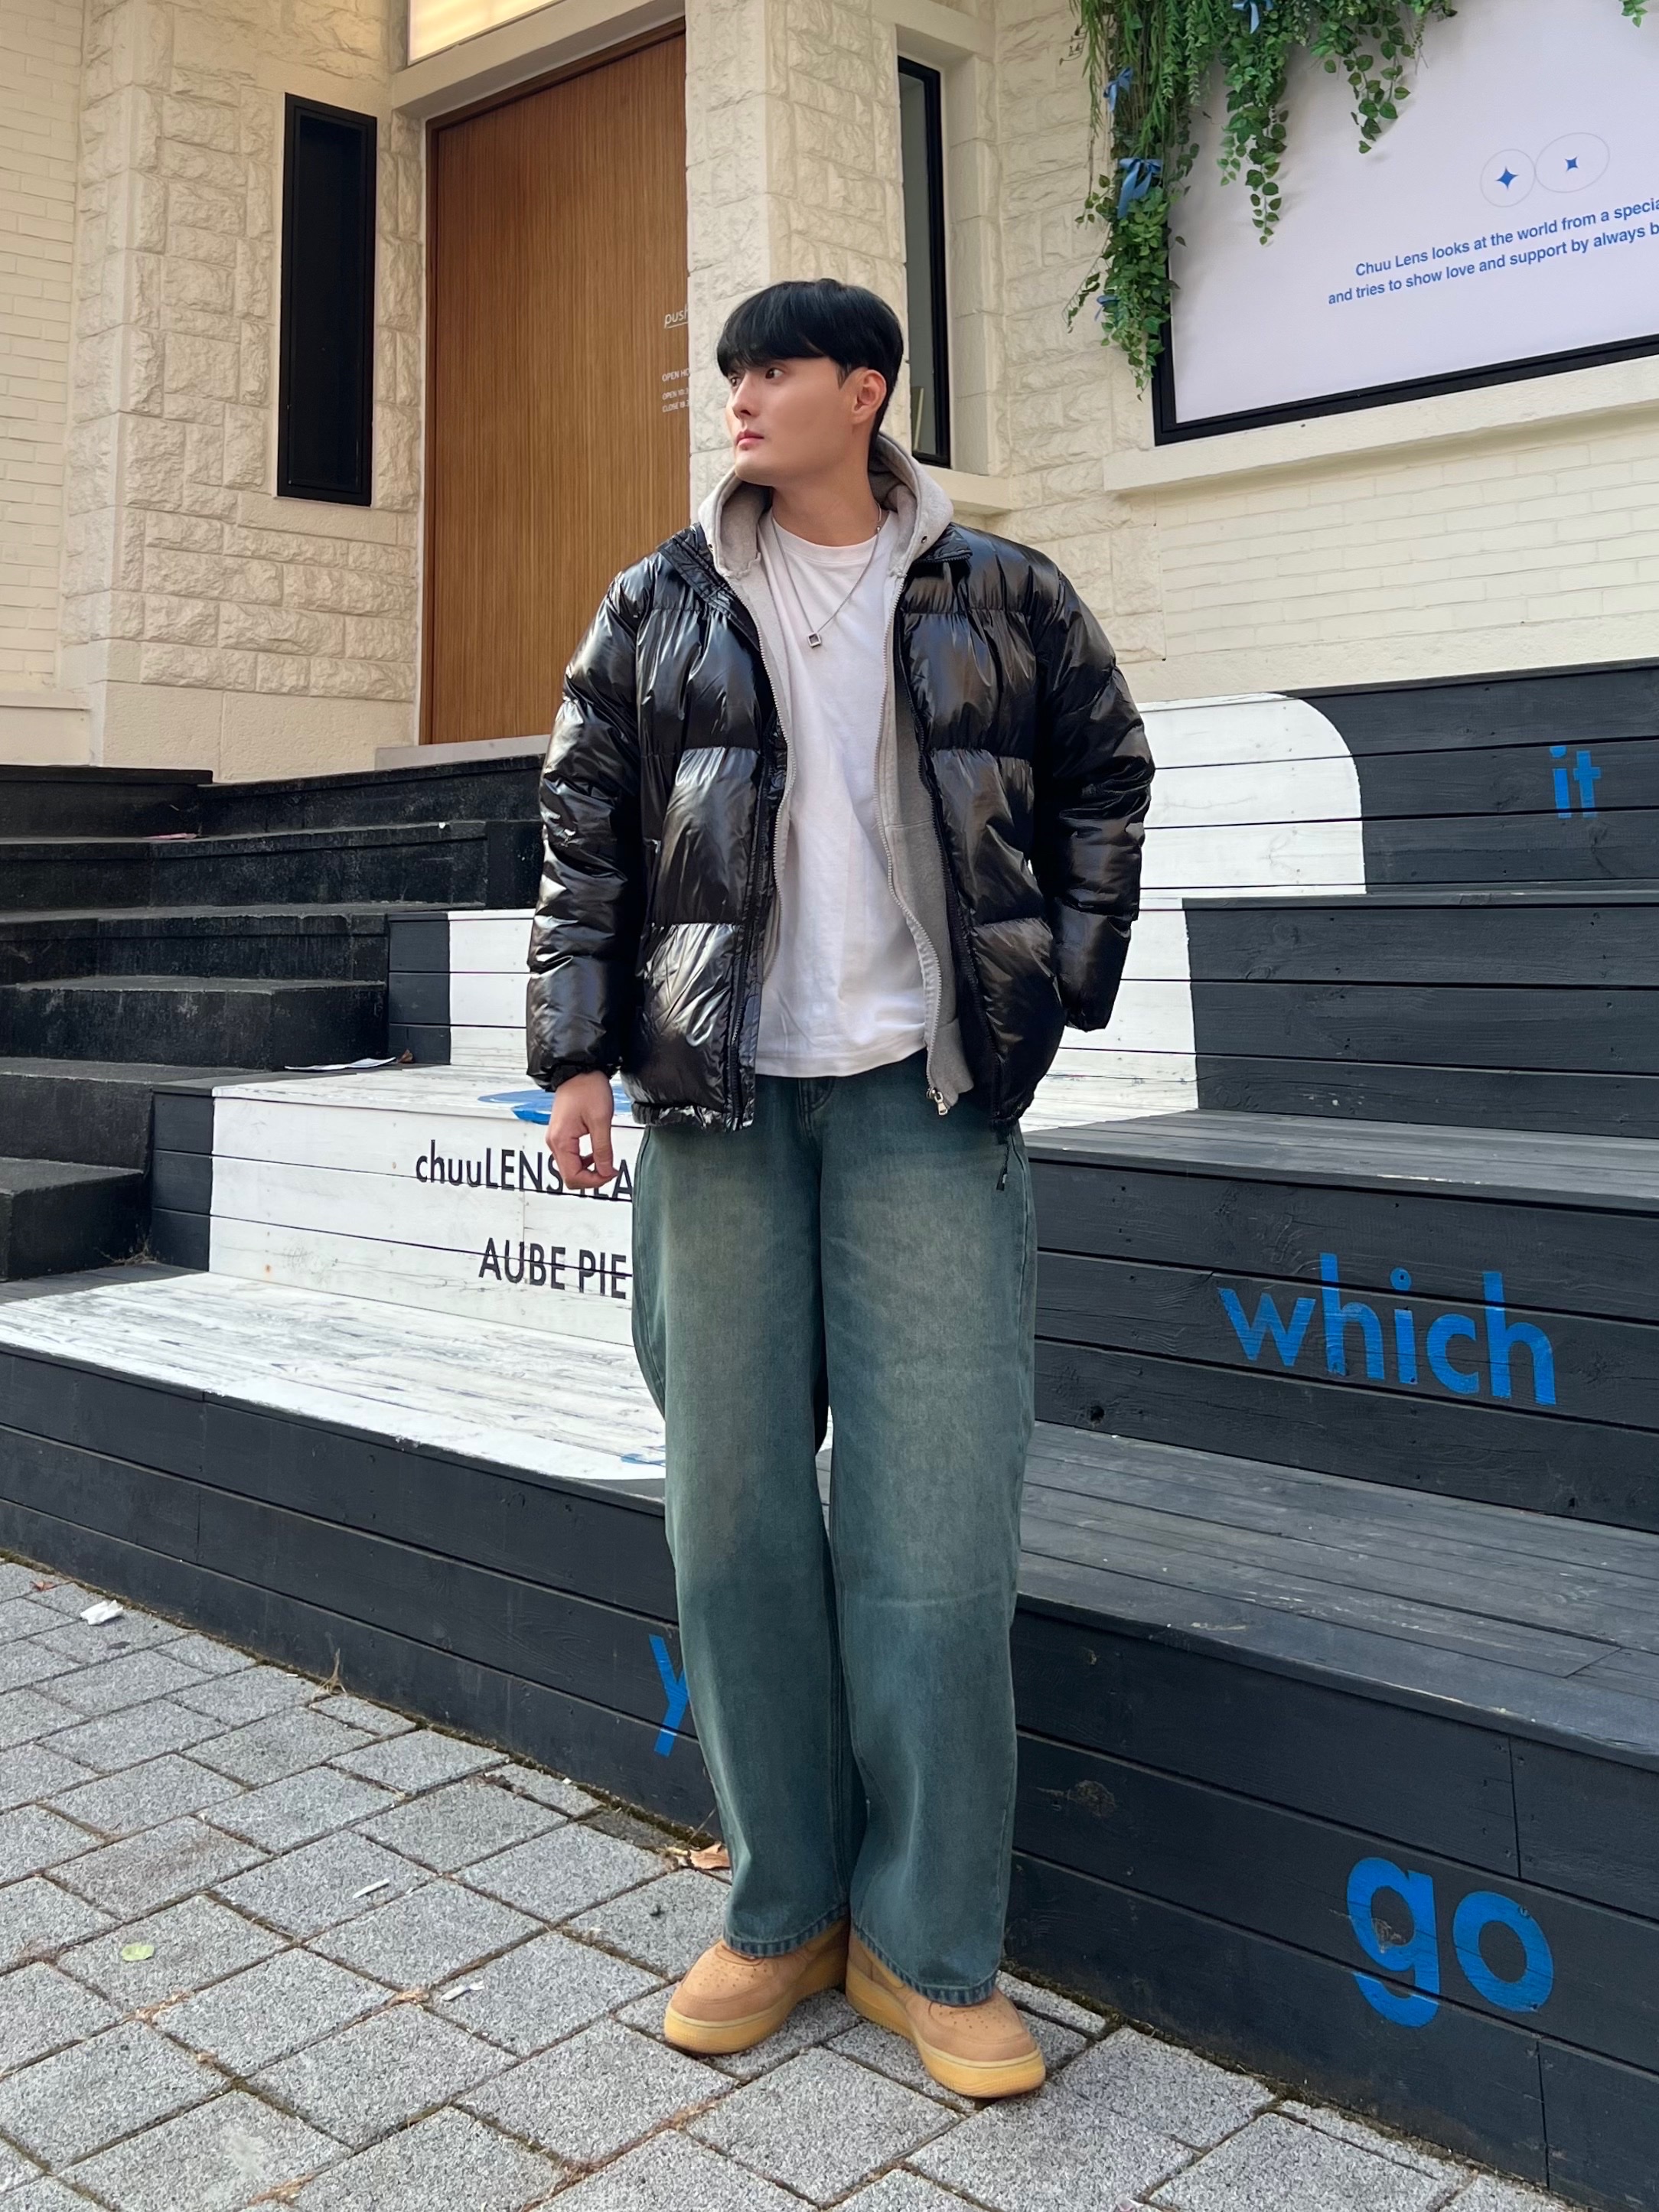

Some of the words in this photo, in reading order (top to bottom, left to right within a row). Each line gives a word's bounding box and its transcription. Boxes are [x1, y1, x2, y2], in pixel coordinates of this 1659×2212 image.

[1328, 288, 1353, 305] and
[1355, 284, 1385, 298] tries
[1389, 279, 1402, 292] to
[1406, 271, 1442, 287] show
[1446, 263, 1475, 279] love
[1478, 255, 1506, 272] and
[1509, 241, 1568, 265] support
[1571, 239, 1589, 253] by
[1593, 226, 1646, 247] always
[1355, 260, 1392, 276] Chuu
[1395, 251, 1429, 268] Lens
[1432, 242, 1470, 259] looks
[1474, 236, 1488, 251] at
[1491, 233, 1514, 246] the
[1517, 220, 1558, 240] world
[1561, 213, 1596, 230] from
[1600, 210, 1610, 222] a
[662, 370, 680, 382] OPEN
[662, 390, 677, 400] OPEN
[662, 402, 679, 412] CLOSE
[1550, 746, 1602, 819] it
[416, 1139, 563, 1194] chuuLENS
[478, 1237, 565, 1290] AUBE
[579, 1249, 627, 1299] PIE
[1217, 1253, 1556, 1406] which
[1347, 1857, 1555, 2028] go
